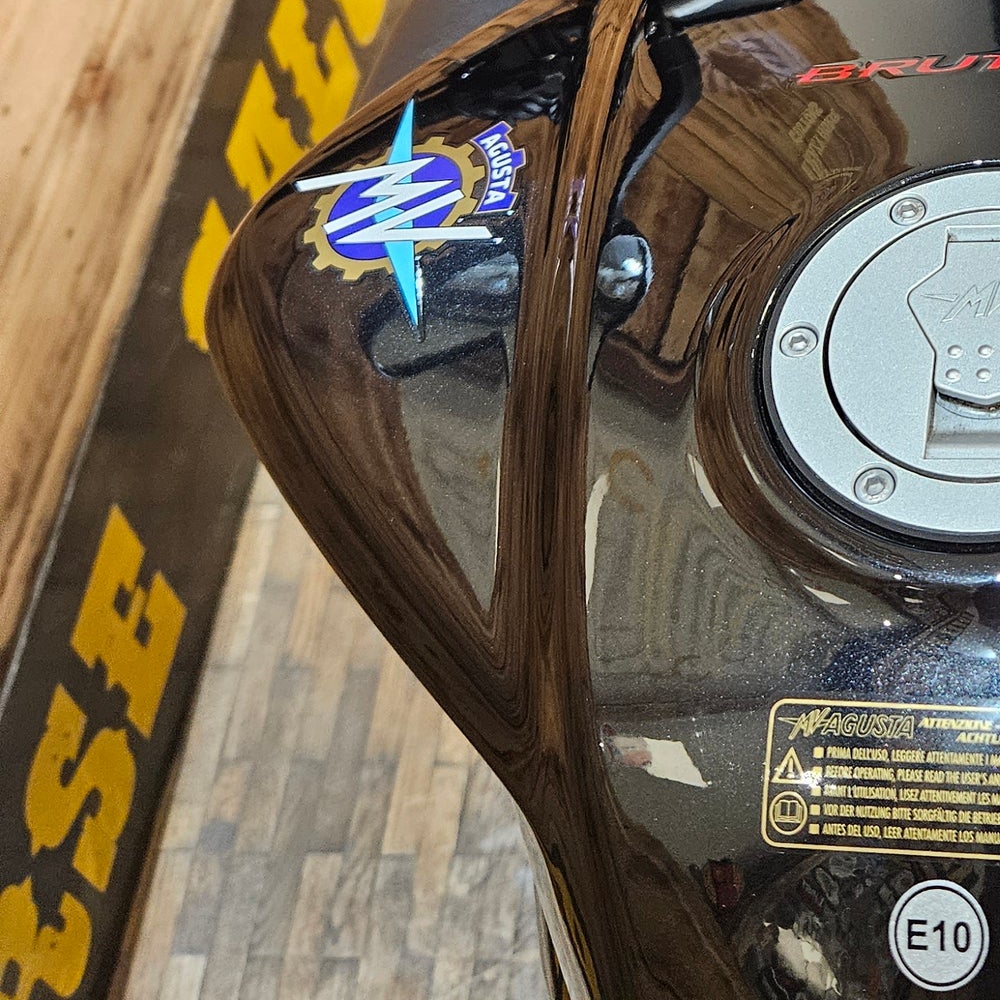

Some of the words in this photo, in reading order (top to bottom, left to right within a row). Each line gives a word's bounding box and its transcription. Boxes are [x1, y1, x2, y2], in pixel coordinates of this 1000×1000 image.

[479, 133, 512, 205] AGUSTA
[821, 713, 915, 739] AGUSTA
[917, 717, 993, 731] ATTENZIONE
[826, 746, 851, 759] PRIMA
[891, 749, 926, 763] LEGGERE
[926, 751, 985, 766] ATTENTAMENTE
[824, 765, 853, 778] BEFORE
[896, 768, 924, 782] PLEASE
[924, 769, 945, 783] READ
[945, 770, 960, 784] THE
[960, 771, 988, 785] USER'S
[899, 788, 920, 801] LISEZ
[920, 789, 977, 804] ATTENTIVEMENT
[977, 791, 991, 805] LES
[823, 803, 839, 816] VOR
[839, 804, 855, 817] DER
[855, 805, 891, 819] NUTZUNG
[891, 807, 912, 820] BITTE
[958, 810, 972, 823] DIE
[822, 823, 847, 836] ANTES
[847, 824, 862, 837] DEL
[882, 826, 903, 839] LEER
[903, 827, 958, 843] ATENTAMENTE
[958, 830, 975, 843] LOS
[907, 918, 971, 954] E10
